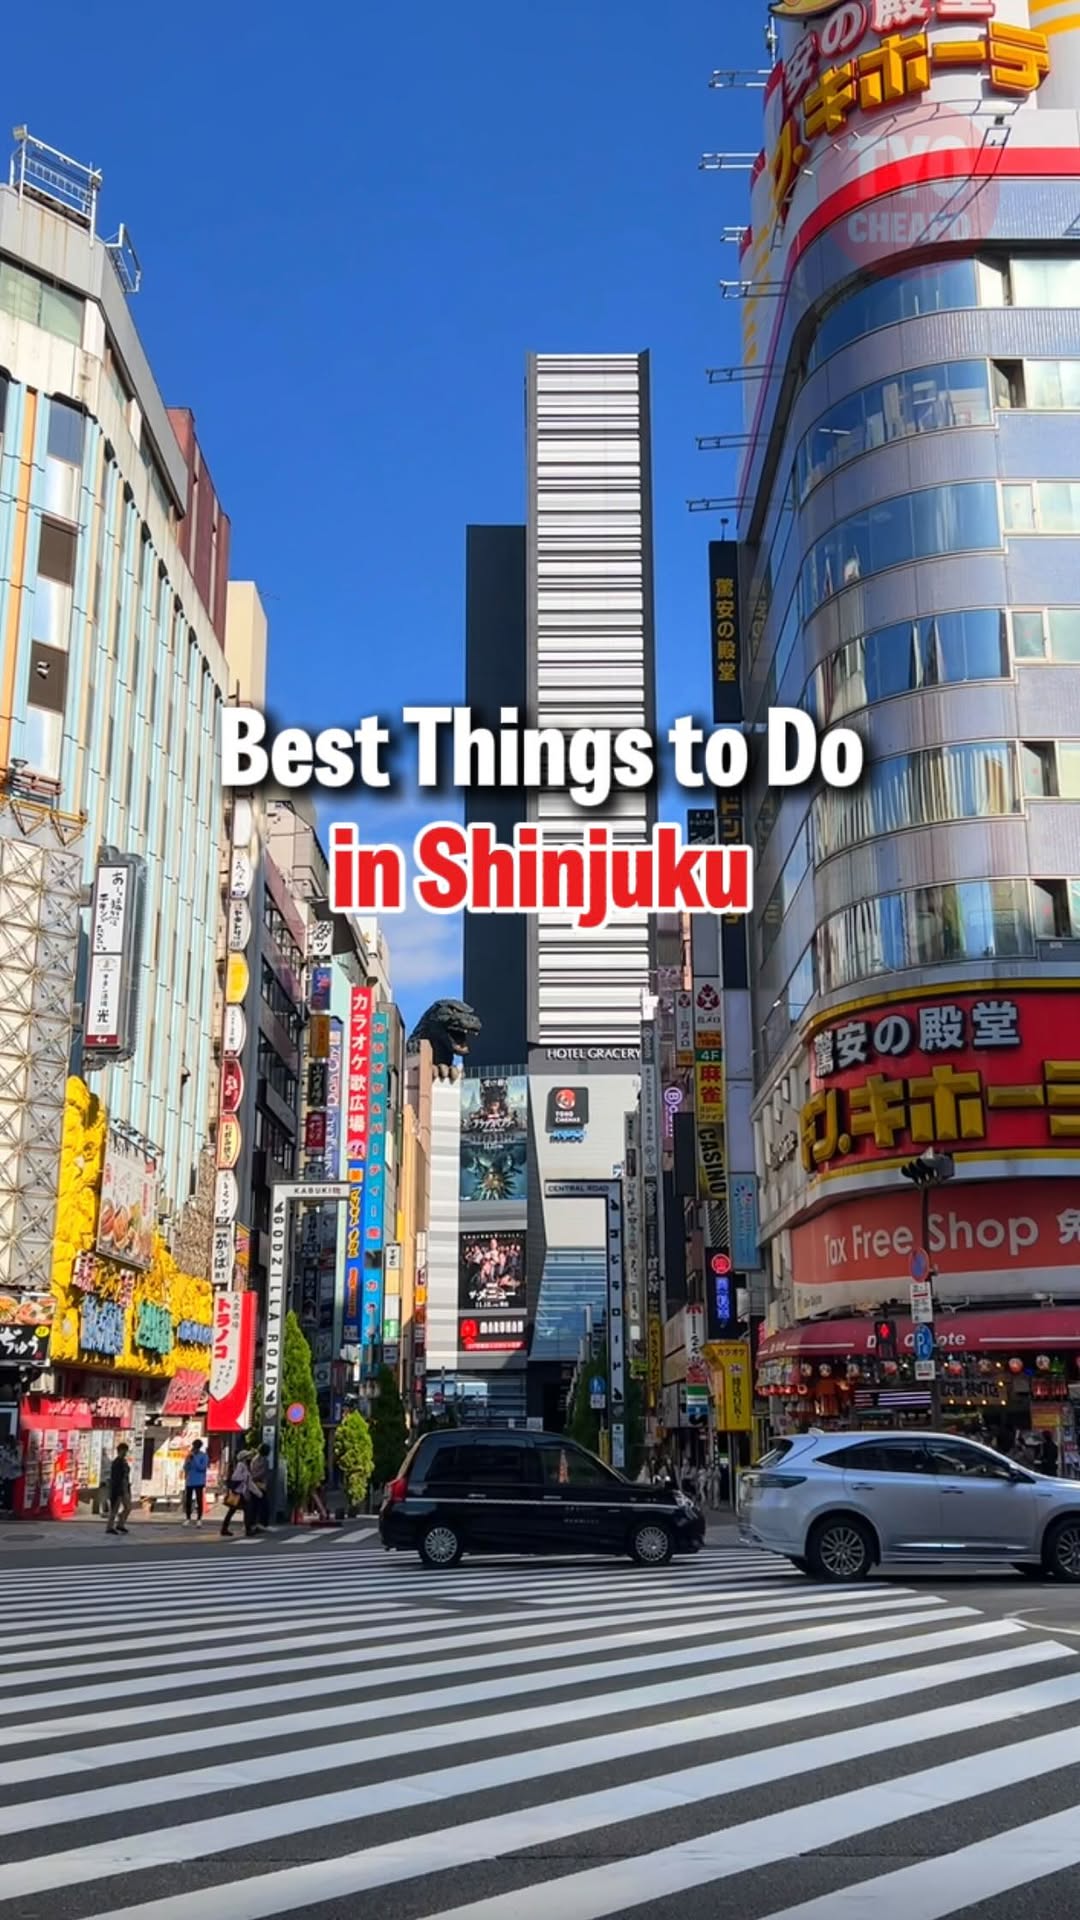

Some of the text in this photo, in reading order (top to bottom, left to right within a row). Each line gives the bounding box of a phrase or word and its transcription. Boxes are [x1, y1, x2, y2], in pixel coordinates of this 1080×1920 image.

[716, 577, 737, 682] 驚安の殿堂
[349, 993, 368, 1133] カラオケ歌広場
[547, 1048, 641, 1060] HOTEL GRACERY
[700, 1051, 719, 1060] 4F
[813, 999, 1022, 1079] 驚安の殿堂
[701, 1065, 721, 1105] 麻雀
[547, 1185, 610, 1193] CENTRAL ROAD
[698, 1127, 727, 1195] CASINO
[824, 1211, 1039, 1268] Tax Free Shop
[214, 1298, 231, 1360] トラノコ
[268, 1215, 284, 1384] GODZILLA ROAD
